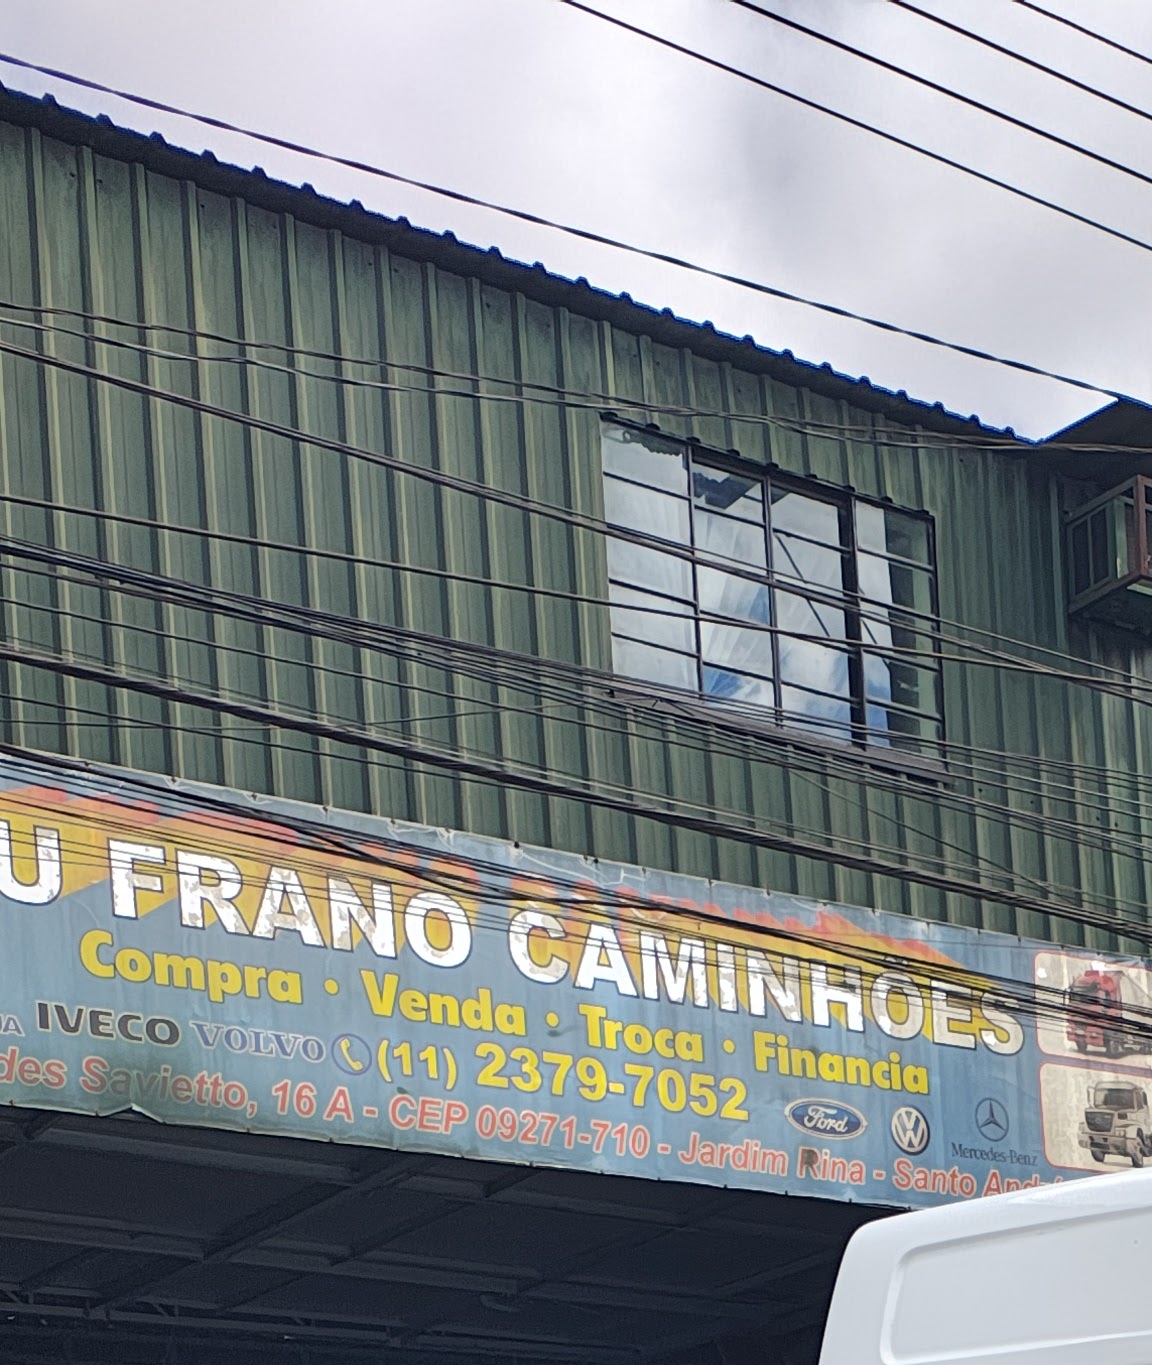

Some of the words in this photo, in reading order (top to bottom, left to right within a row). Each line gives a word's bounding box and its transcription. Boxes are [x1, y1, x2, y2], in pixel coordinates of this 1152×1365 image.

[107, 837, 473, 968] FRANO
[509, 905, 1024, 1056] CAMINHÕES
[37, 1001, 181, 1046] IVECO
[79, 929, 303, 1004] Compra
[360, 969, 527, 1037] Venda
[579, 1003, 704, 1062] Troca
[753, 1030, 930, 1096] Financia
[193, 1021, 326, 1064] VOLVO
[377, 1038, 459, 1091] (11)
[476, 1042, 749, 1122] 2379-7052
[80, 1055, 257, 1118] Savietto,
[271, 1080, 317, 1117] 16
[323, 1085, 355, 1124] A
[389, 1094, 468, 1135] CEP
[476, 1104, 650, 1162] 09271-710
[679, 1135, 788, 1178] Jardim
[798, 1146, 868, 1185] Rina
[893, 1158, 976, 1197] Santo
[804, 1105, 849, 1133] Ford
[951, 1142, 1038, 1167] Mercedes-Benz
